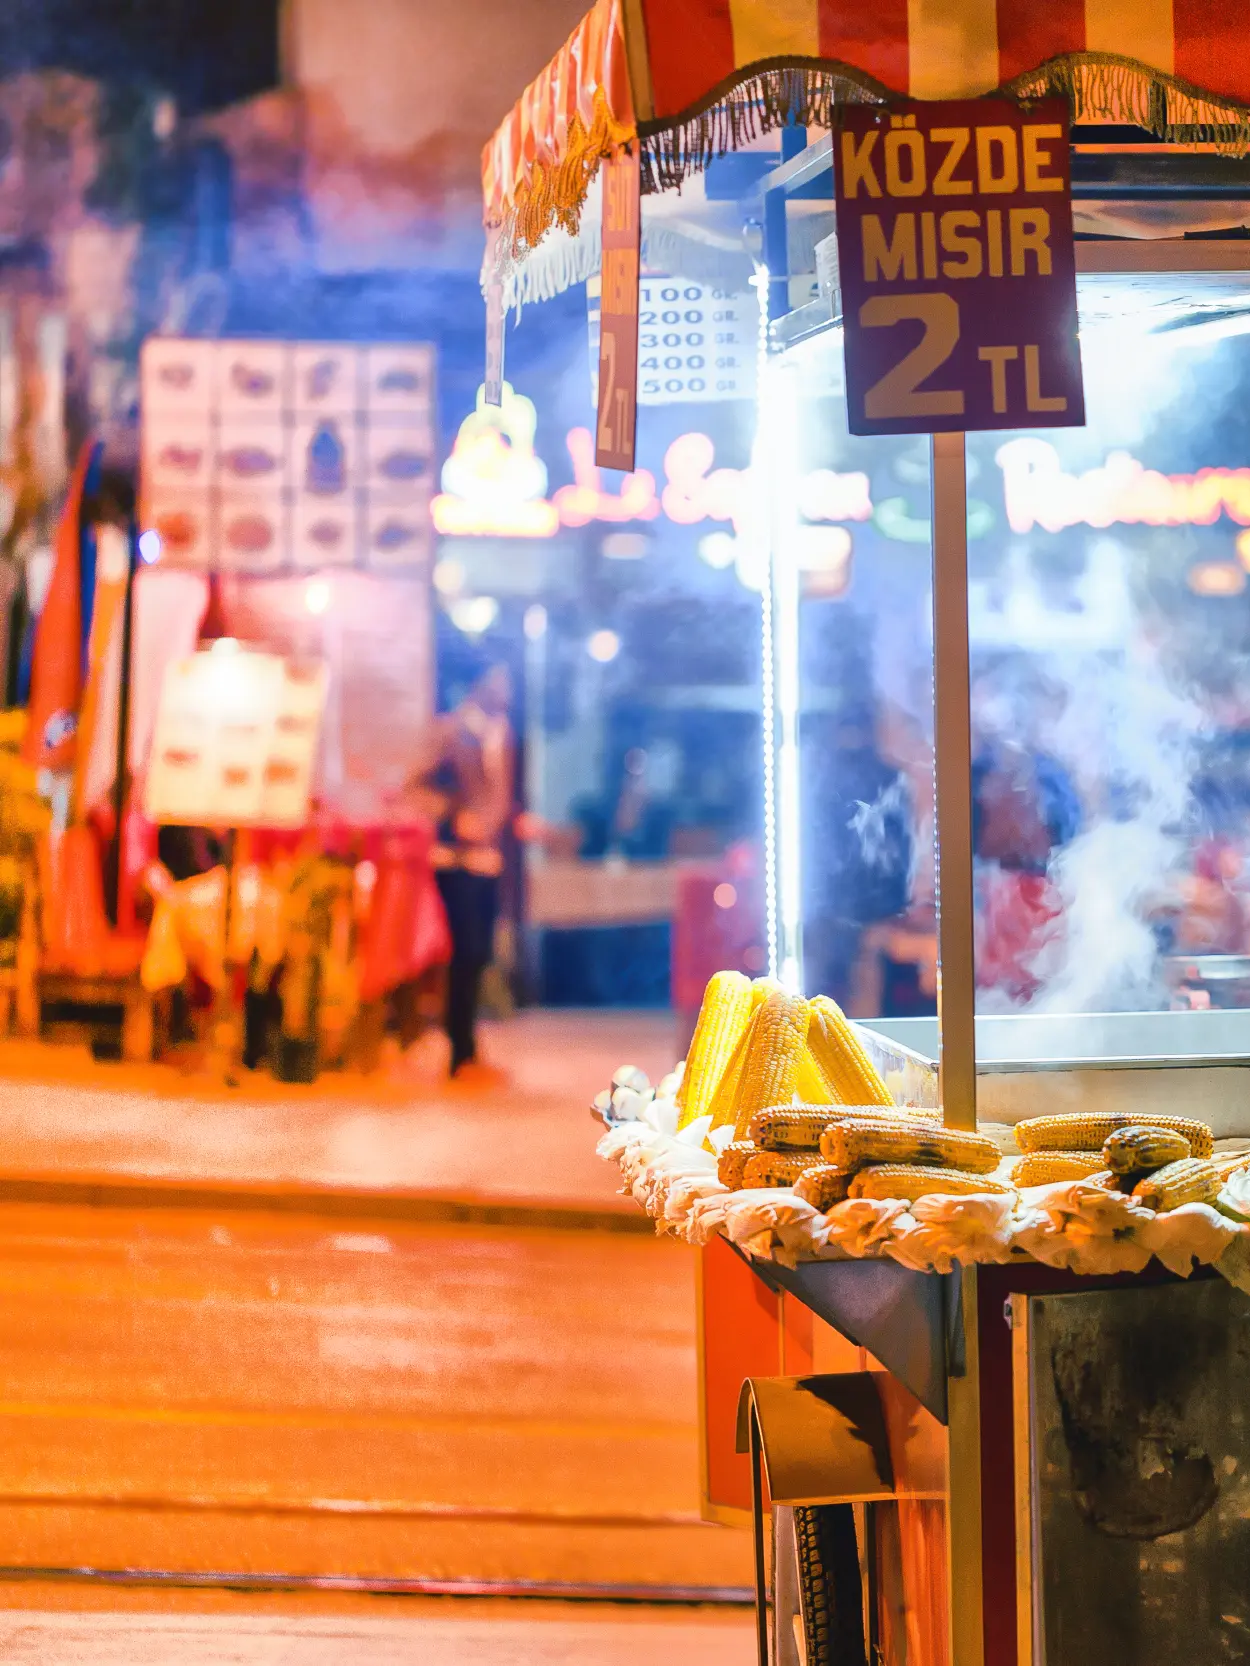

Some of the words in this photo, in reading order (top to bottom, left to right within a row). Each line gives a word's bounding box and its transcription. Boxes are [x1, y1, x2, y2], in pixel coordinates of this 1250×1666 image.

[841, 114, 1064, 199] KÖZDE
[861, 207, 1052, 282] MISIR
[641, 286, 703, 302] 100
[640, 310, 703, 325] 200
[641, 332, 704, 348] 300
[641, 355, 705, 370] 400
[859, 293, 965, 419] 2
[978, 345, 1068, 413] TL
[598, 332, 616, 451] 2
[615, 388, 632, 454] TL
[642, 378, 706, 394] 500
